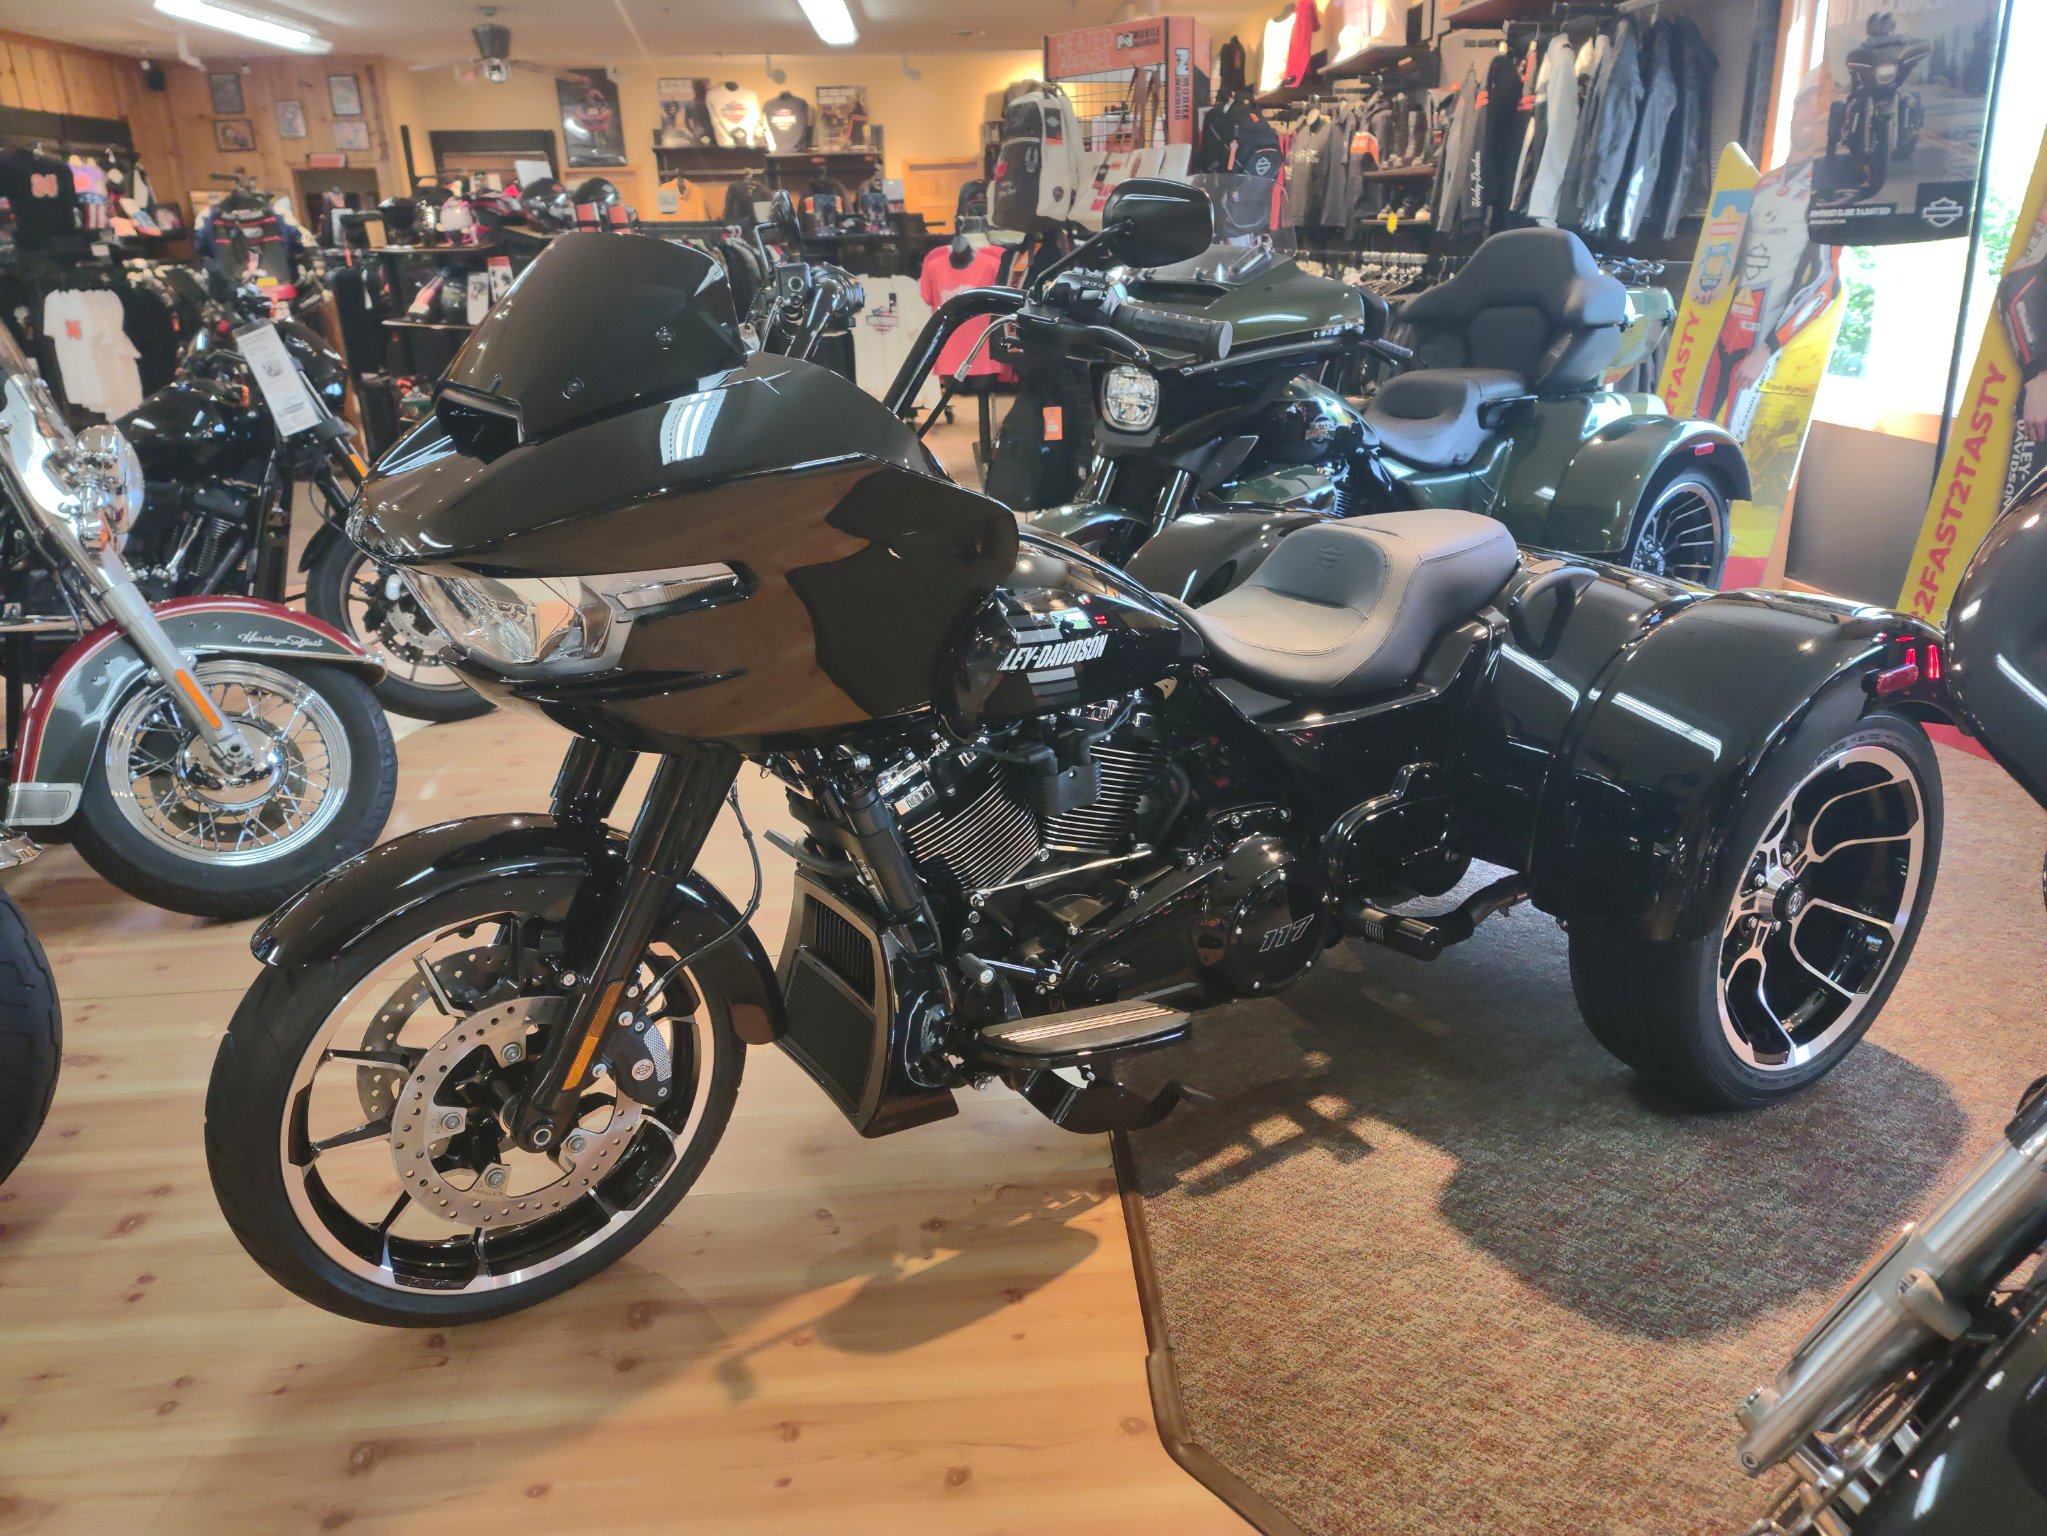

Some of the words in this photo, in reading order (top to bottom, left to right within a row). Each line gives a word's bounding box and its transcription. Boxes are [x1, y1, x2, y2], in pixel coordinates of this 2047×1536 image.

[1056, 28, 1114, 53] HEATED
[1182, 77, 1190, 121] MOBILE
[2018, 436, 2036, 481] LEY-
[996, 633, 1109, 671] LEY-DAVIDSON
[1259, 913, 1315, 952] 117
